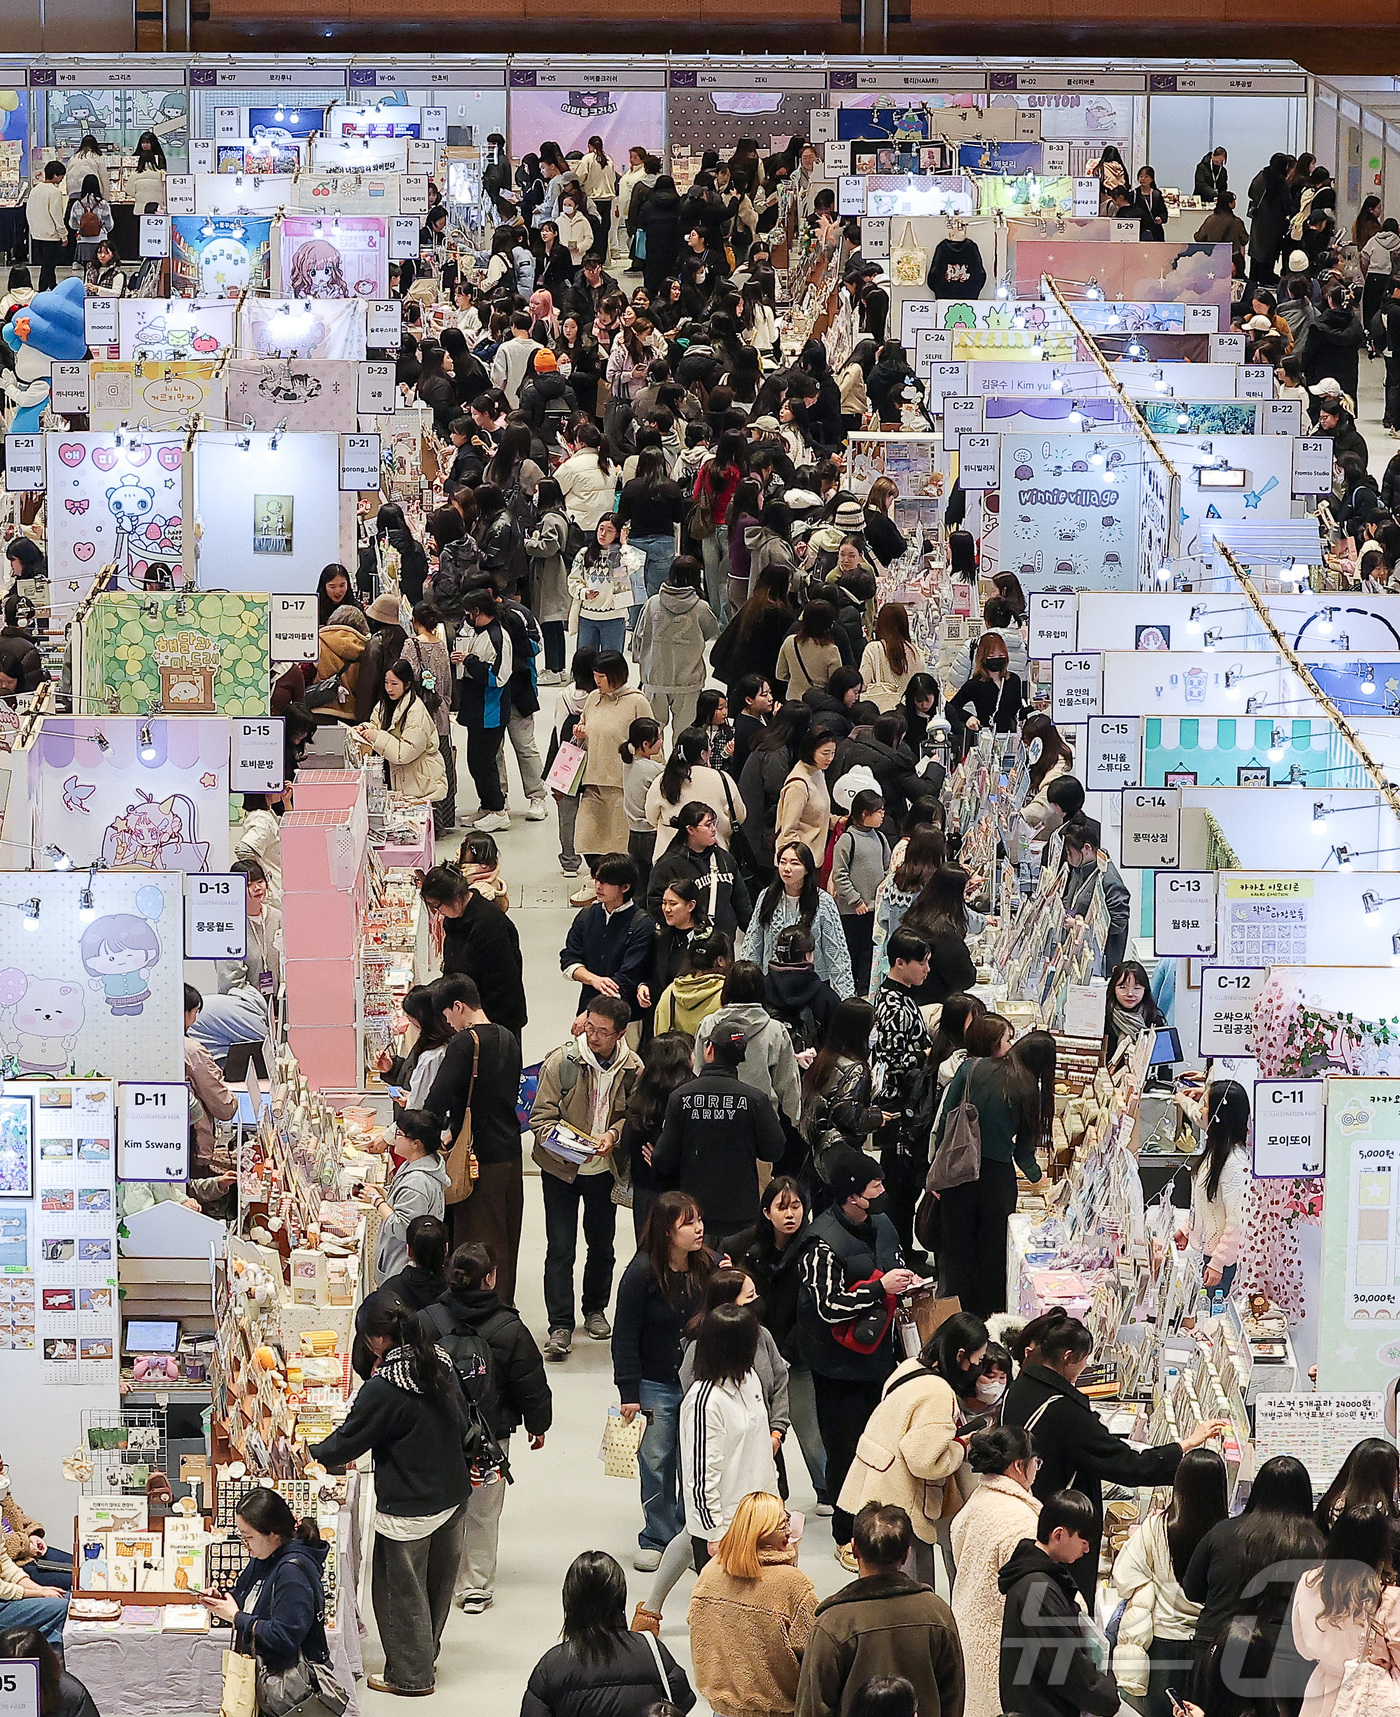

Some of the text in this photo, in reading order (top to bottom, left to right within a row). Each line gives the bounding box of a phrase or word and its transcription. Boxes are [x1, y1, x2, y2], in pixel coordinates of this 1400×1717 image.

[1027, 95, 1081, 109] BUTTON
[193, 141, 209, 149] E-33
[146, 219, 163, 227] E-29
[396, 220, 413, 228] D-29
[367, 235, 377, 247] &
[375, 304, 394, 312] D-25
[910, 305, 930, 313] C-25
[1192, 309, 1212, 317] B-25
[924, 334, 946, 342] C-24
[1218, 338, 1239, 346] B-24
[60, 366, 80, 374] E-23
[367, 366, 388, 375] D-23
[939, 366, 960, 375] C-23
[1244, 370, 1265, 378] B-23
[981, 379, 1035, 391] 김윤수 Kim
[952, 401, 974, 410] C-22
[1271, 405, 1293, 413] B-22
[14, 439, 34, 448] E-21
[349, 439, 369, 448] D-21
[968, 438, 990, 447] C-21
[1302, 443, 1323, 451] B-21
[341, 465, 379, 474] gorong_lab
[963, 464, 996, 473] 위니빌리지
[281, 601, 305, 610] D-17
[1041, 599, 1065, 610] C-17
[274, 632, 314, 641] 해달과마들렌
[1037, 629, 1068, 639] 투유럽미
[156, 631, 212, 654] 해달과
[170, 651, 220, 673] 마들렌
[1064, 661, 1091, 671] C-16
[1066, 687, 1090, 697] 요인의
[1058, 697, 1097, 708] 인물스티커
[243, 725, 270, 736] D-15
[1101, 723, 1128, 734] C-15
[239, 759, 274, 770] 토비문방
[1097, 762, 1131, 772] 스튜디오
[1135, 795, 1166, 808] C-14
[1132, 831, 1169, 843] 콩떡상점
[199, 882, 230, 894] D-13
[1169, 879, 1201, 892] C-13
[1239, 882, 1300, 892] 카카오 이모티콘
[1171, 918, 1200, 930] 월하묘
[1217, 975, 1251, 989] C-12
[134, 1092, 167, 1106] D-11
[682, 1094, 748, 1110] KOREA
[1271, 1090, 1304, 1104] C-11
[690, 1109, 737, 1120] ARMY
[124, 1139, 182, 1151] Kim Sswang
[1267, 1135, 1311, 1146] 모이또이
[1358, 1149, 1395, 1159] 5,000원
[1353, 1293, 1396, 1304] 30,000원
[1298, 1400, 1333, 1411] 5개골라
[1335, 1399, 1372, 1410] 24000원
[1260, 1411, 1292, 1421] 개별구매
[1336, 1411, 1357, 1420] 500원
[1360, 1410, 1379, 1421] 할인!
